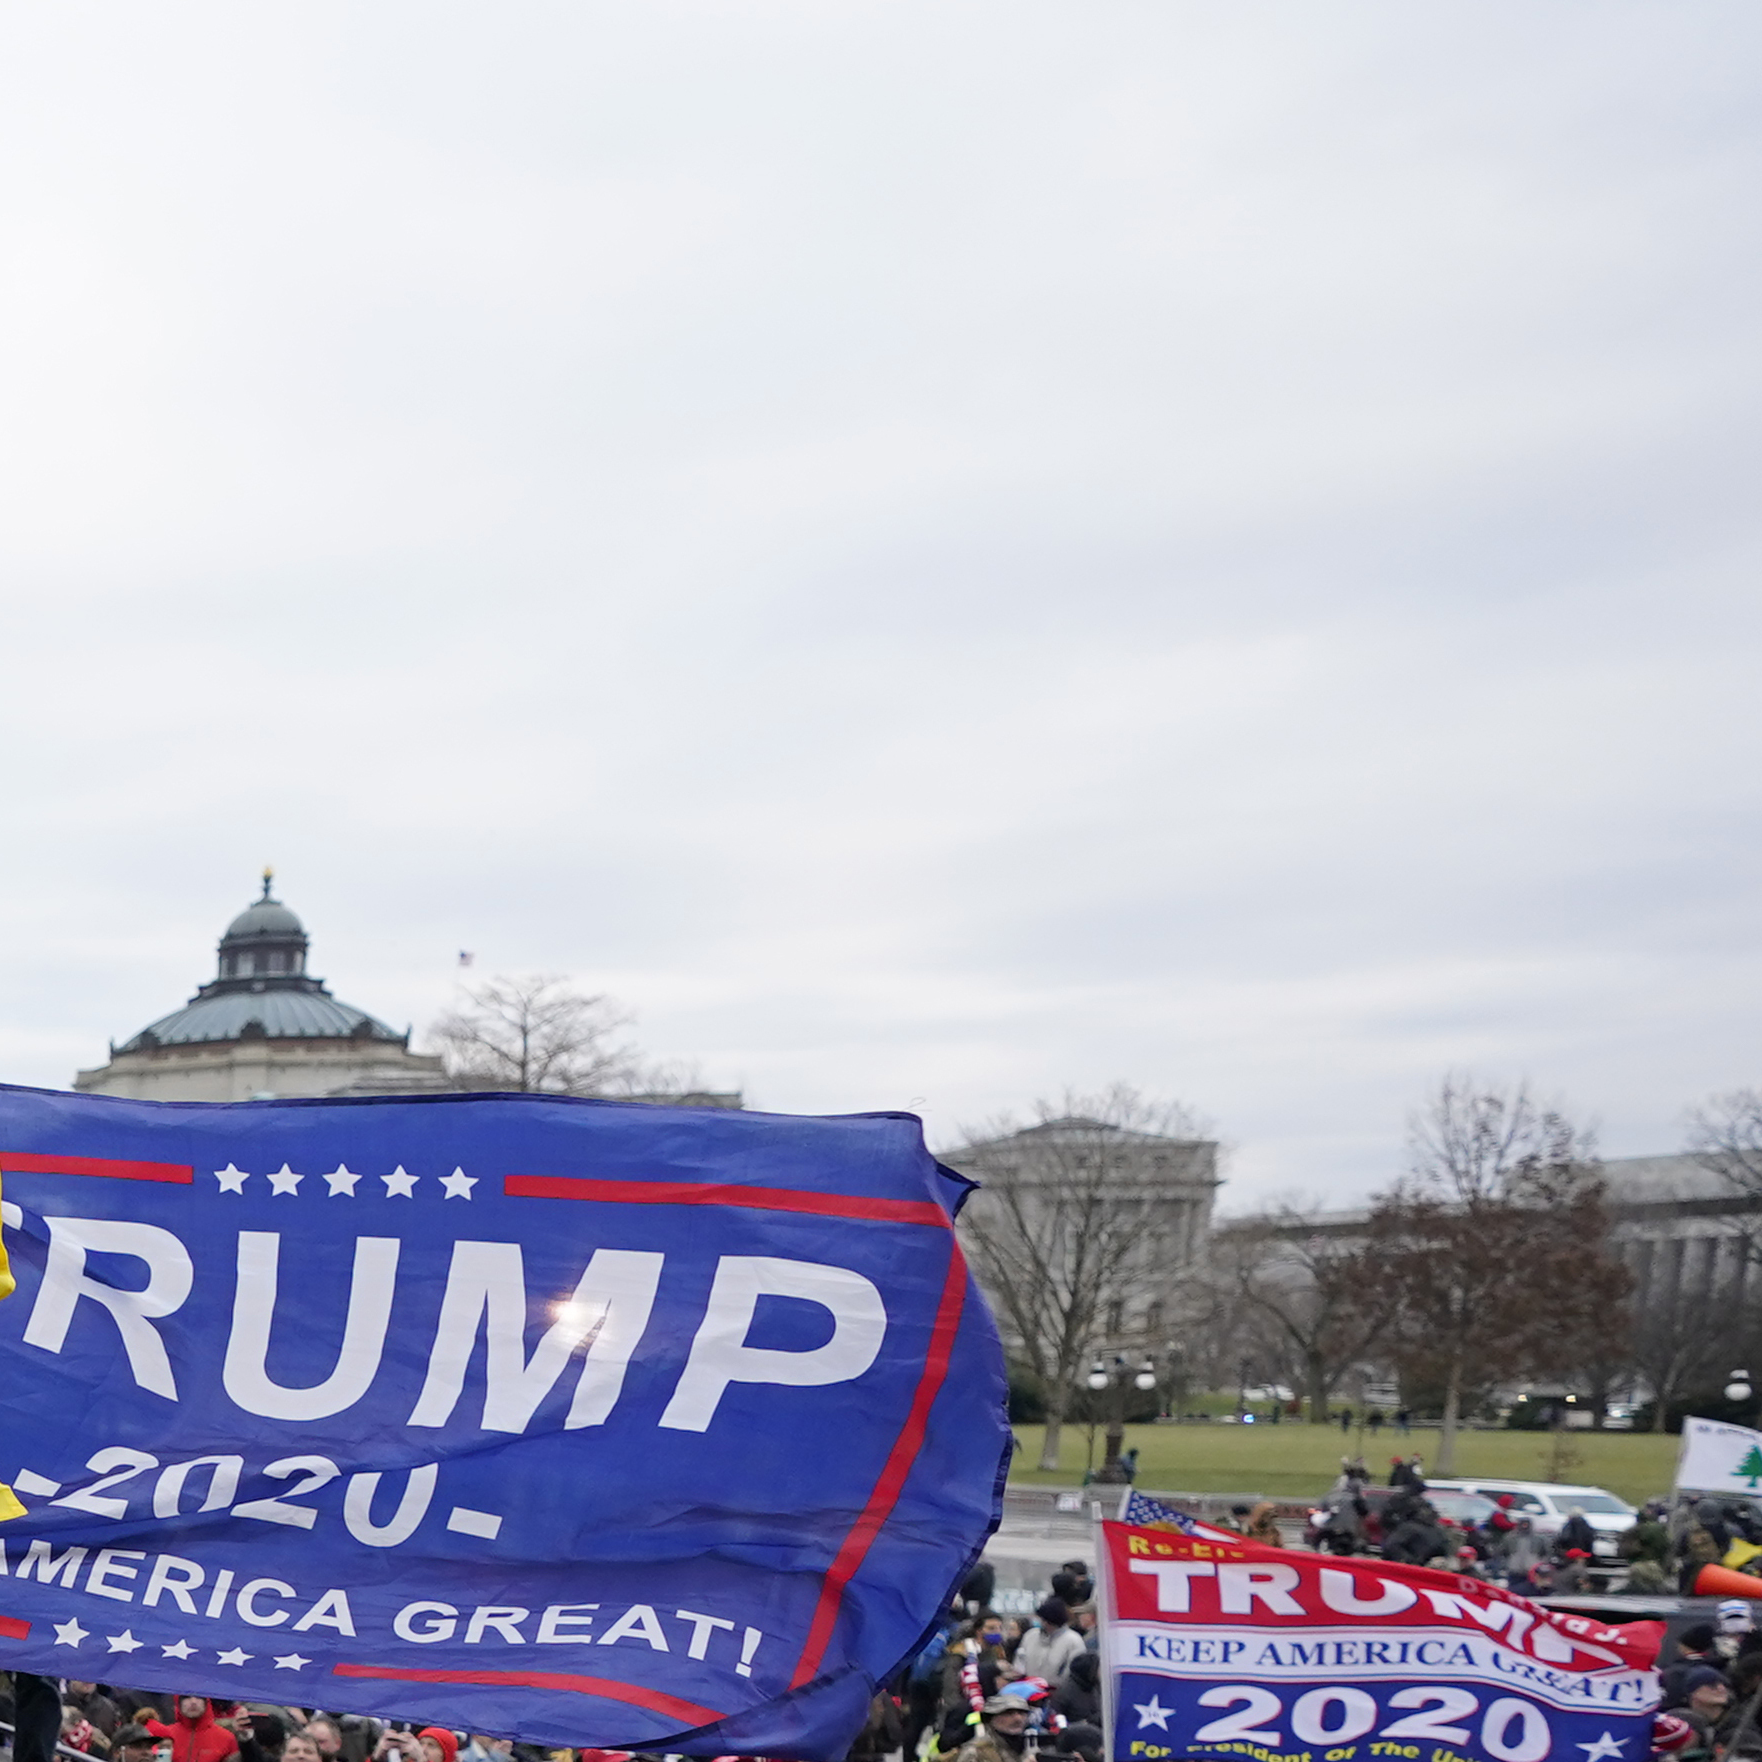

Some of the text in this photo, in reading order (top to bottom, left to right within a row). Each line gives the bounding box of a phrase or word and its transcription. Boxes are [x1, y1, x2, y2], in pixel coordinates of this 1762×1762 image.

[2, 1202, 887, 1436] RUMP
[393, 1601, 762, 1677] GREAT!
[1135, 1634, 1644, 1702] KEEP AMERICA GREAT!
[1130, 1740, 1172, 1759] For
